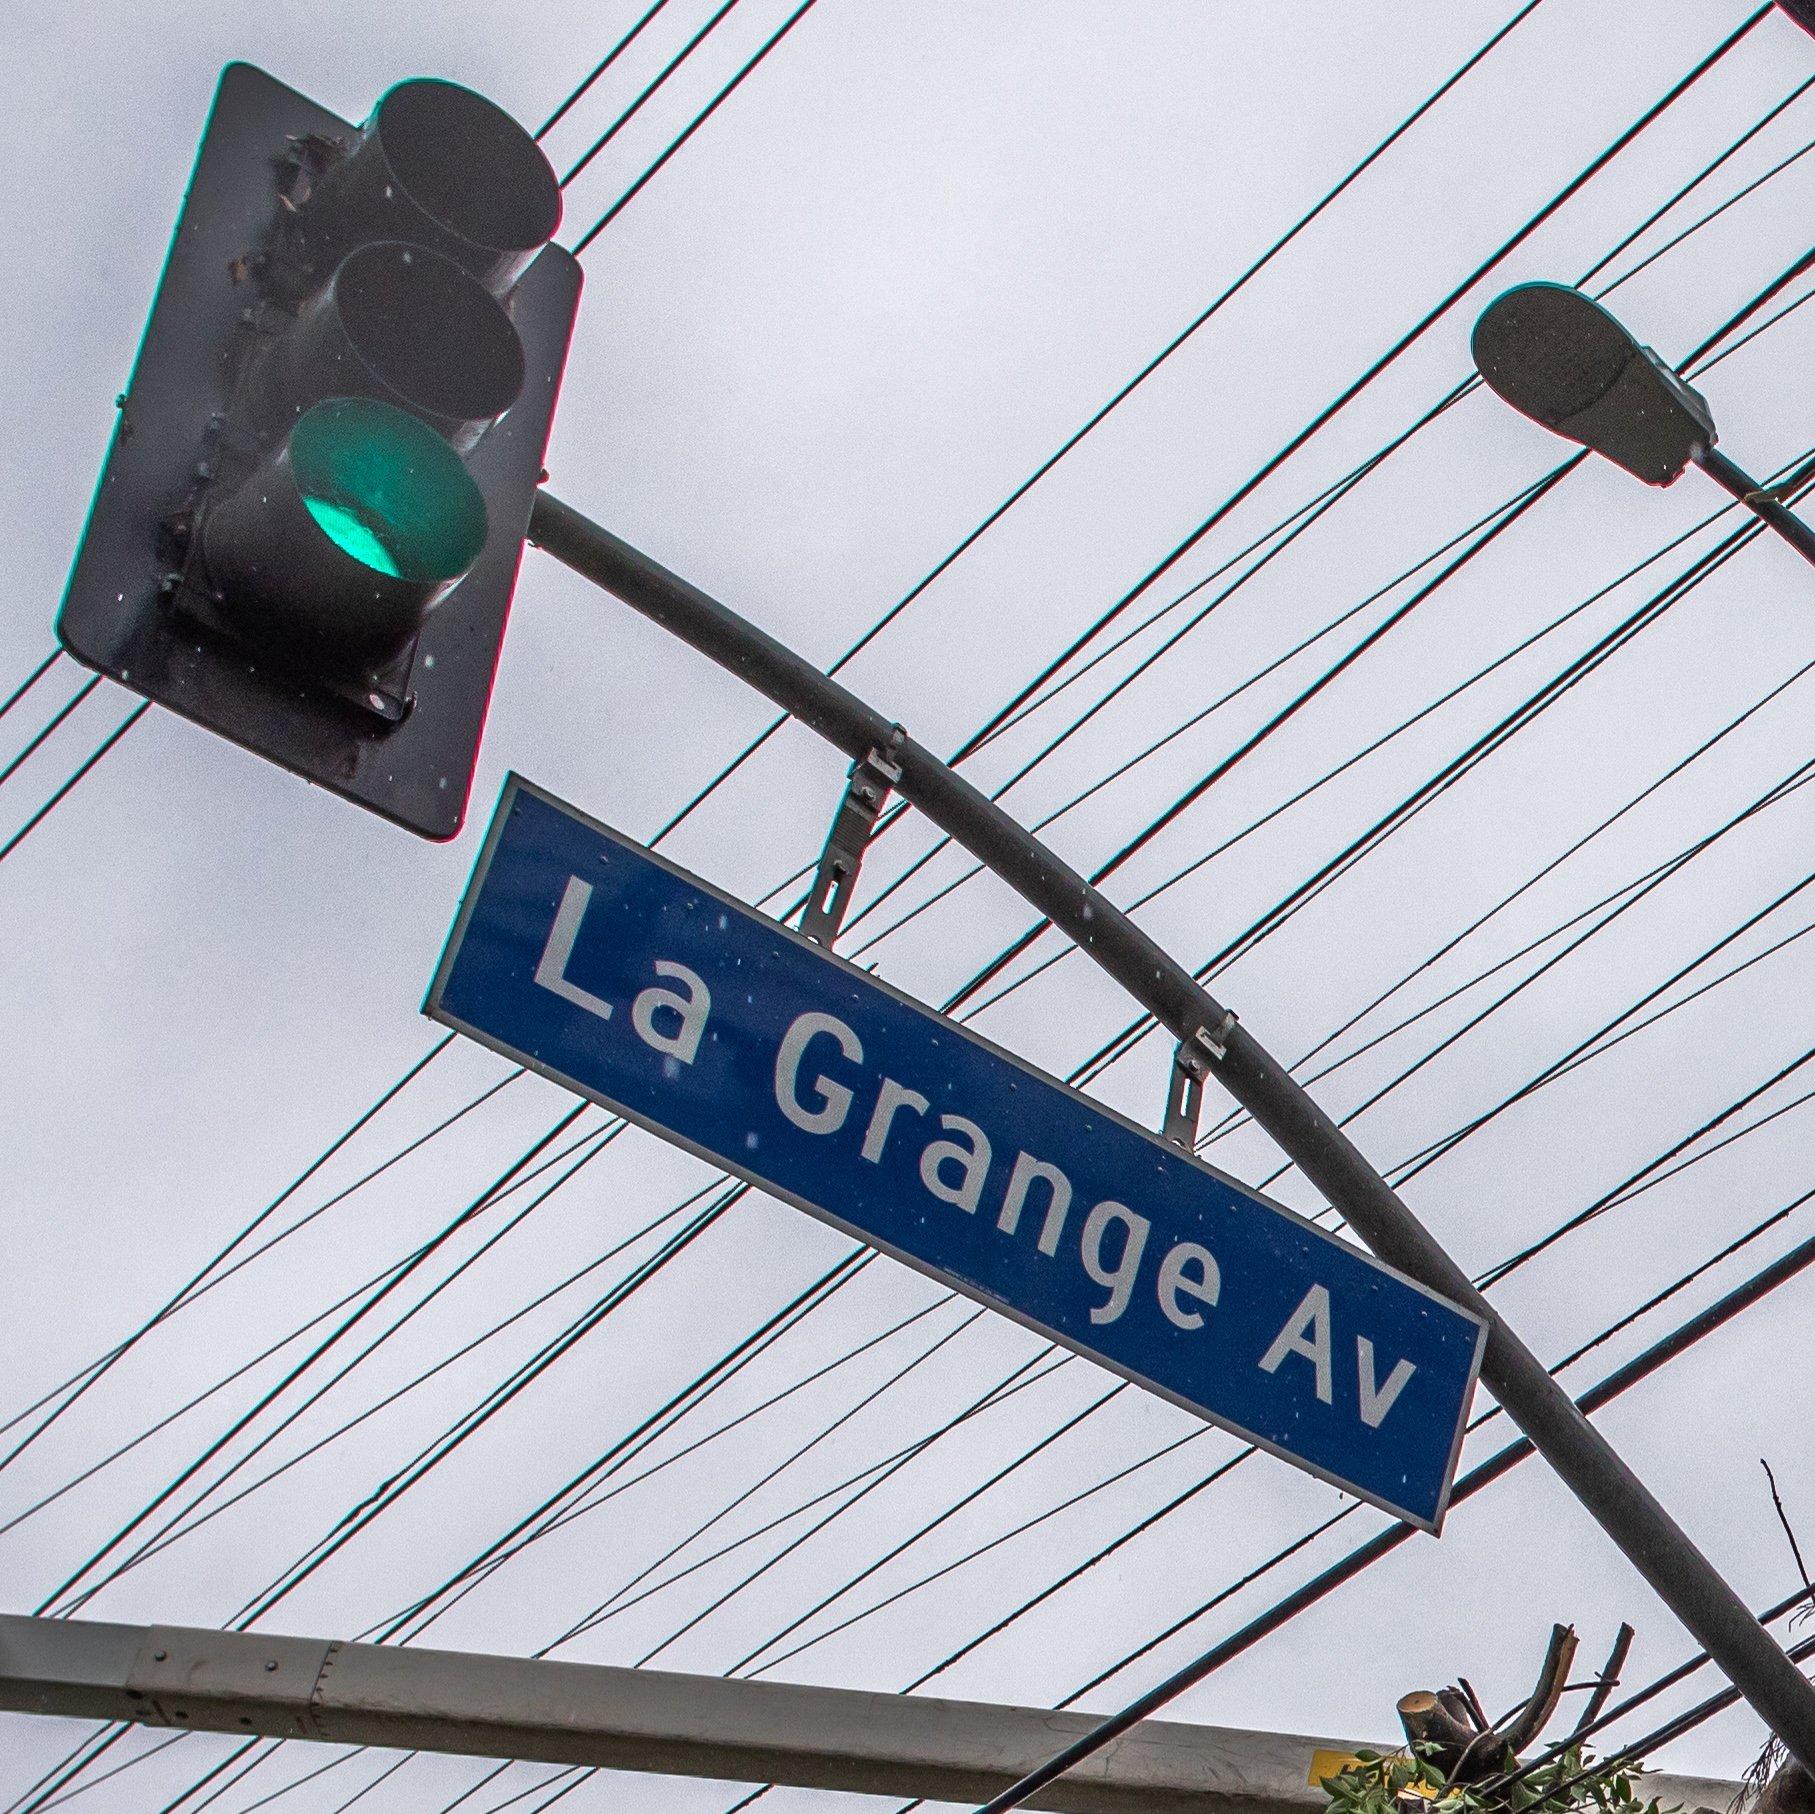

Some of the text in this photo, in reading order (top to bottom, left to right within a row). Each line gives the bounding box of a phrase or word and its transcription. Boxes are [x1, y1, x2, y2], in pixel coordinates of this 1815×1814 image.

[534, 874, 1417, 1428] La Grange Av
